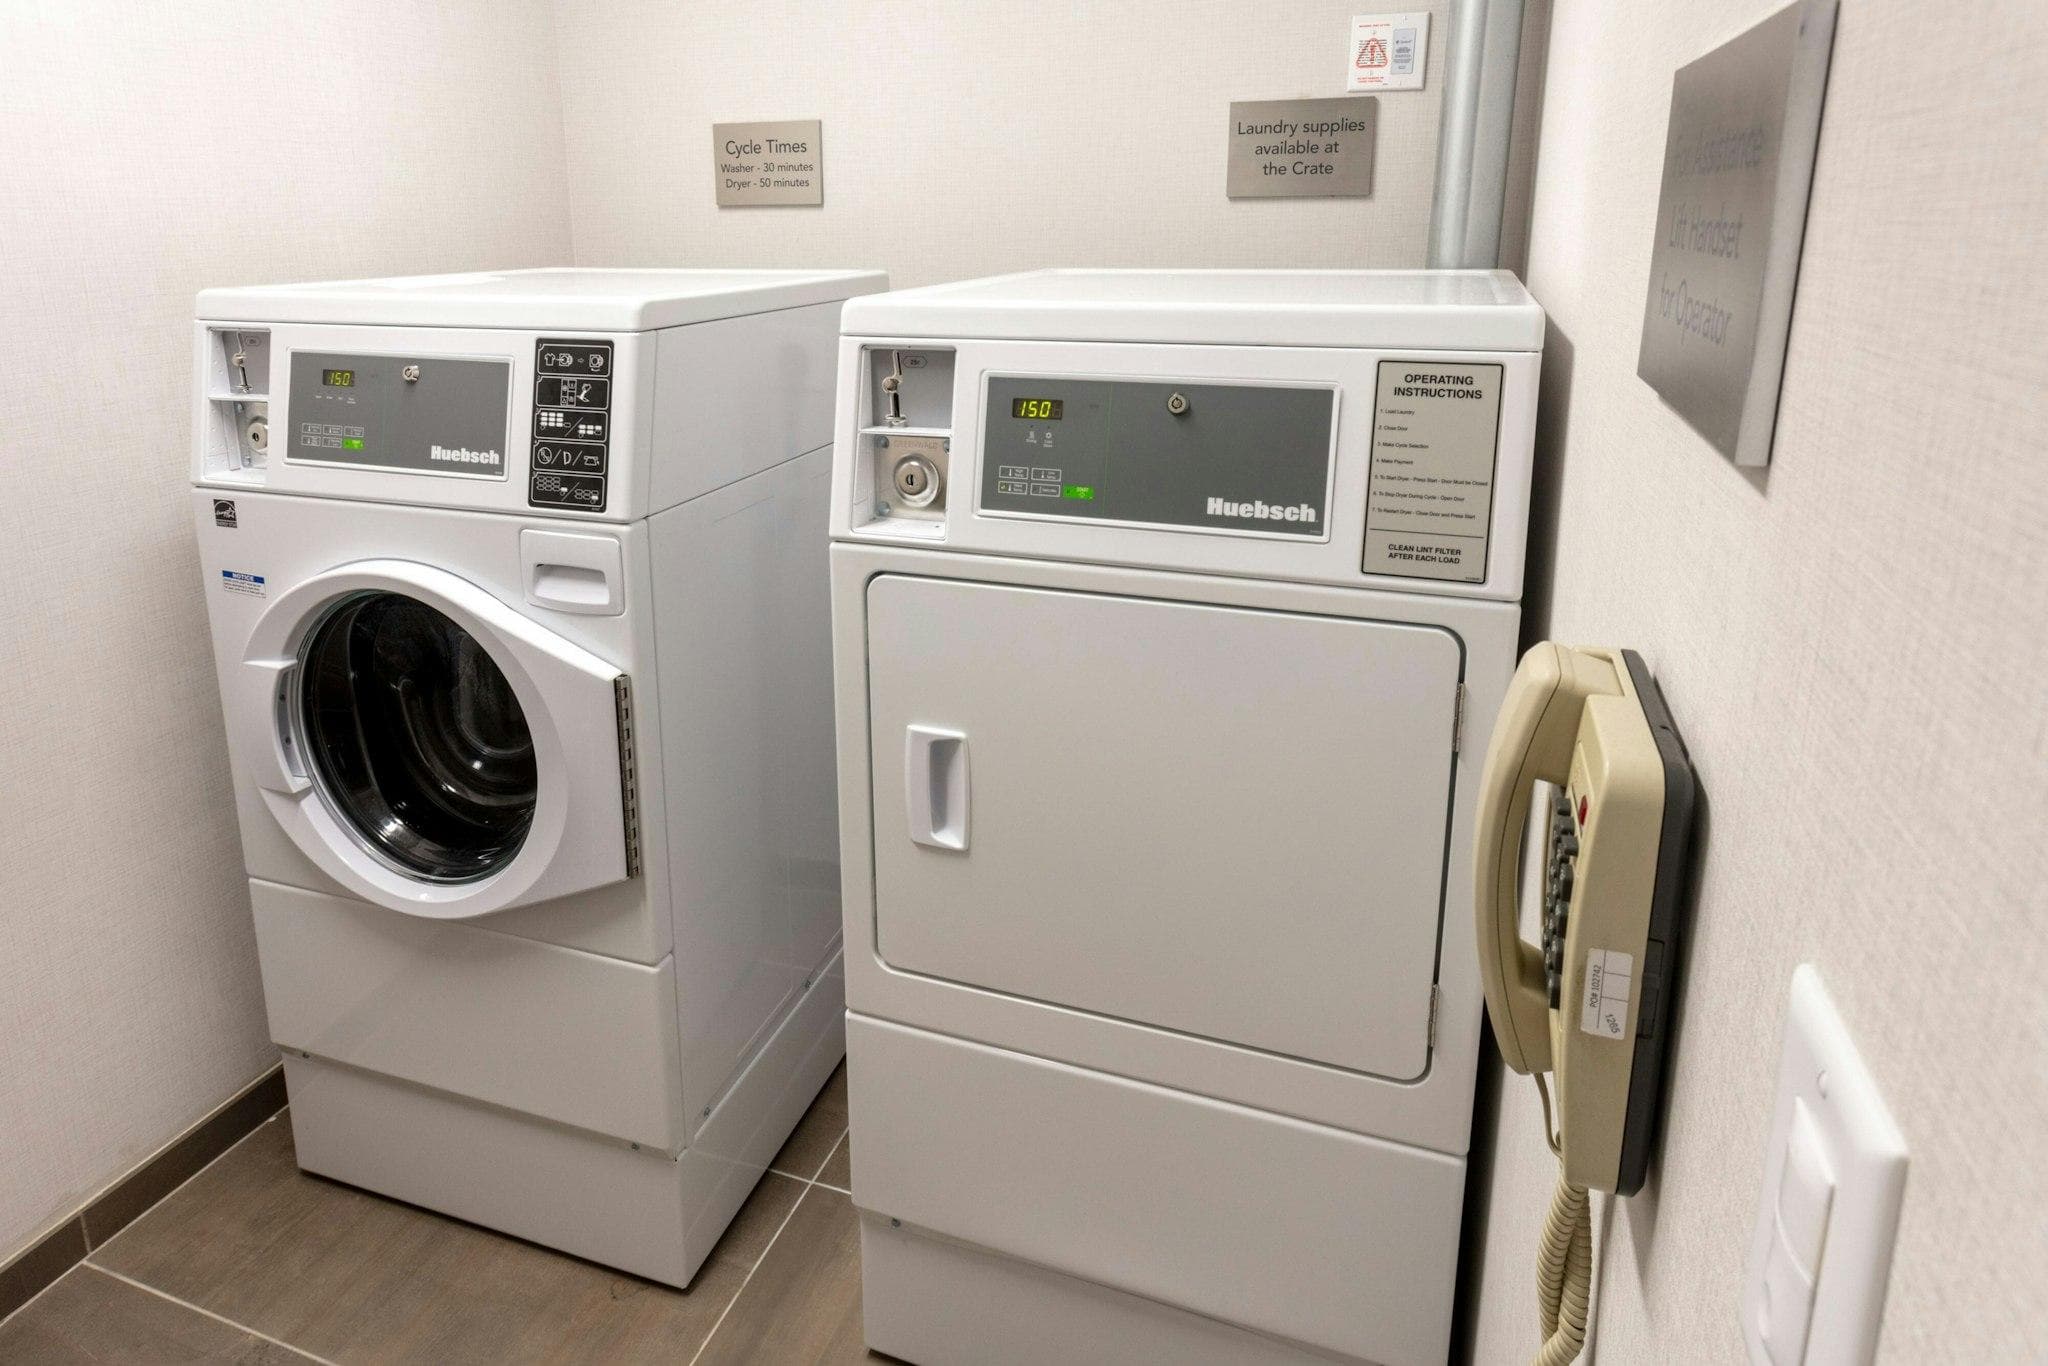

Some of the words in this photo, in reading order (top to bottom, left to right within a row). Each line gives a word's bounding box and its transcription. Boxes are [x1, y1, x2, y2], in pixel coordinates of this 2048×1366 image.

[1237, 119, 1298, 137] Laundry
[1303, 117, 1366, 137] supplies
[725, 139, 761, 158] Cycle
[766, 139, 807, 154] Times
[1254, 140, 1319, 155] available
[1324, 141, 1340, 153] at
[721, 163, 755, 173] Washer
[763, 162, 775, 172] 30
[777, 162, 814, 172] minutes
[1263, 161, 1287, 175] the
[1292, 161, 1334, 175] Crate
[725, 178, 752, 190] Dryer
[760, 177, 771, 187] 50
[773, 177, 810, 187] minutes
[1688, 202, 1744, 259] Handset
[1676, 278, 1733, 346] Operator
[330, 372, 351, 386] 150
[1404, 373, 1474, 386] OPERATING
[1394, 386, 1483, 399] INSTRUCTIONS
[1021, 401, 1052, 418] 150
[1397, 409, 1415, 417] Laundry
[430, 445, 500, 465] Huebsch
[1206, 496, 1317, 523] Huebsch
[1388, 543, 1415, 552] CLEAN
[1416, 545, 1434, 554] LINT
[1434, 547, 1462, 556] FILTER
[1388, 552, 1414, 561] AFTER
[1415, 554, 1437, 562] EACH
[1438, 556, 1461, 564] LOAD
